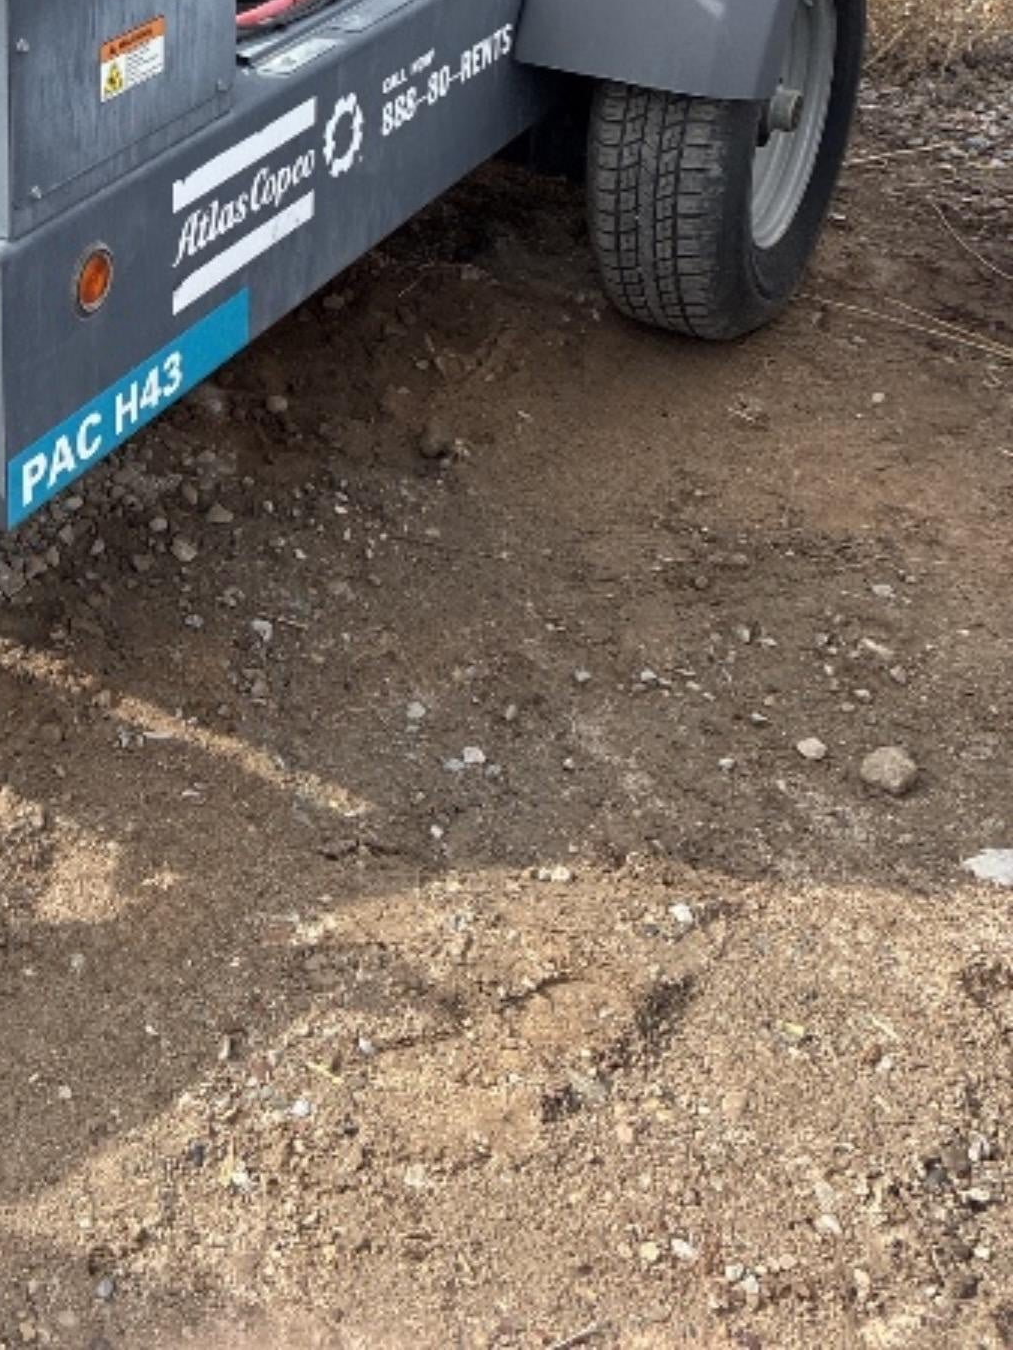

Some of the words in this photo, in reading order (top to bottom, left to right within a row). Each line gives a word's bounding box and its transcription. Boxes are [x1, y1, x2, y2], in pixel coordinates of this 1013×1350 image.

[172, 191, 249, 268] Atlas
[250, 149, 316, 212] Copco
[22, 410, 103, 508] PAC
[114, 350, 184, 436] H43
